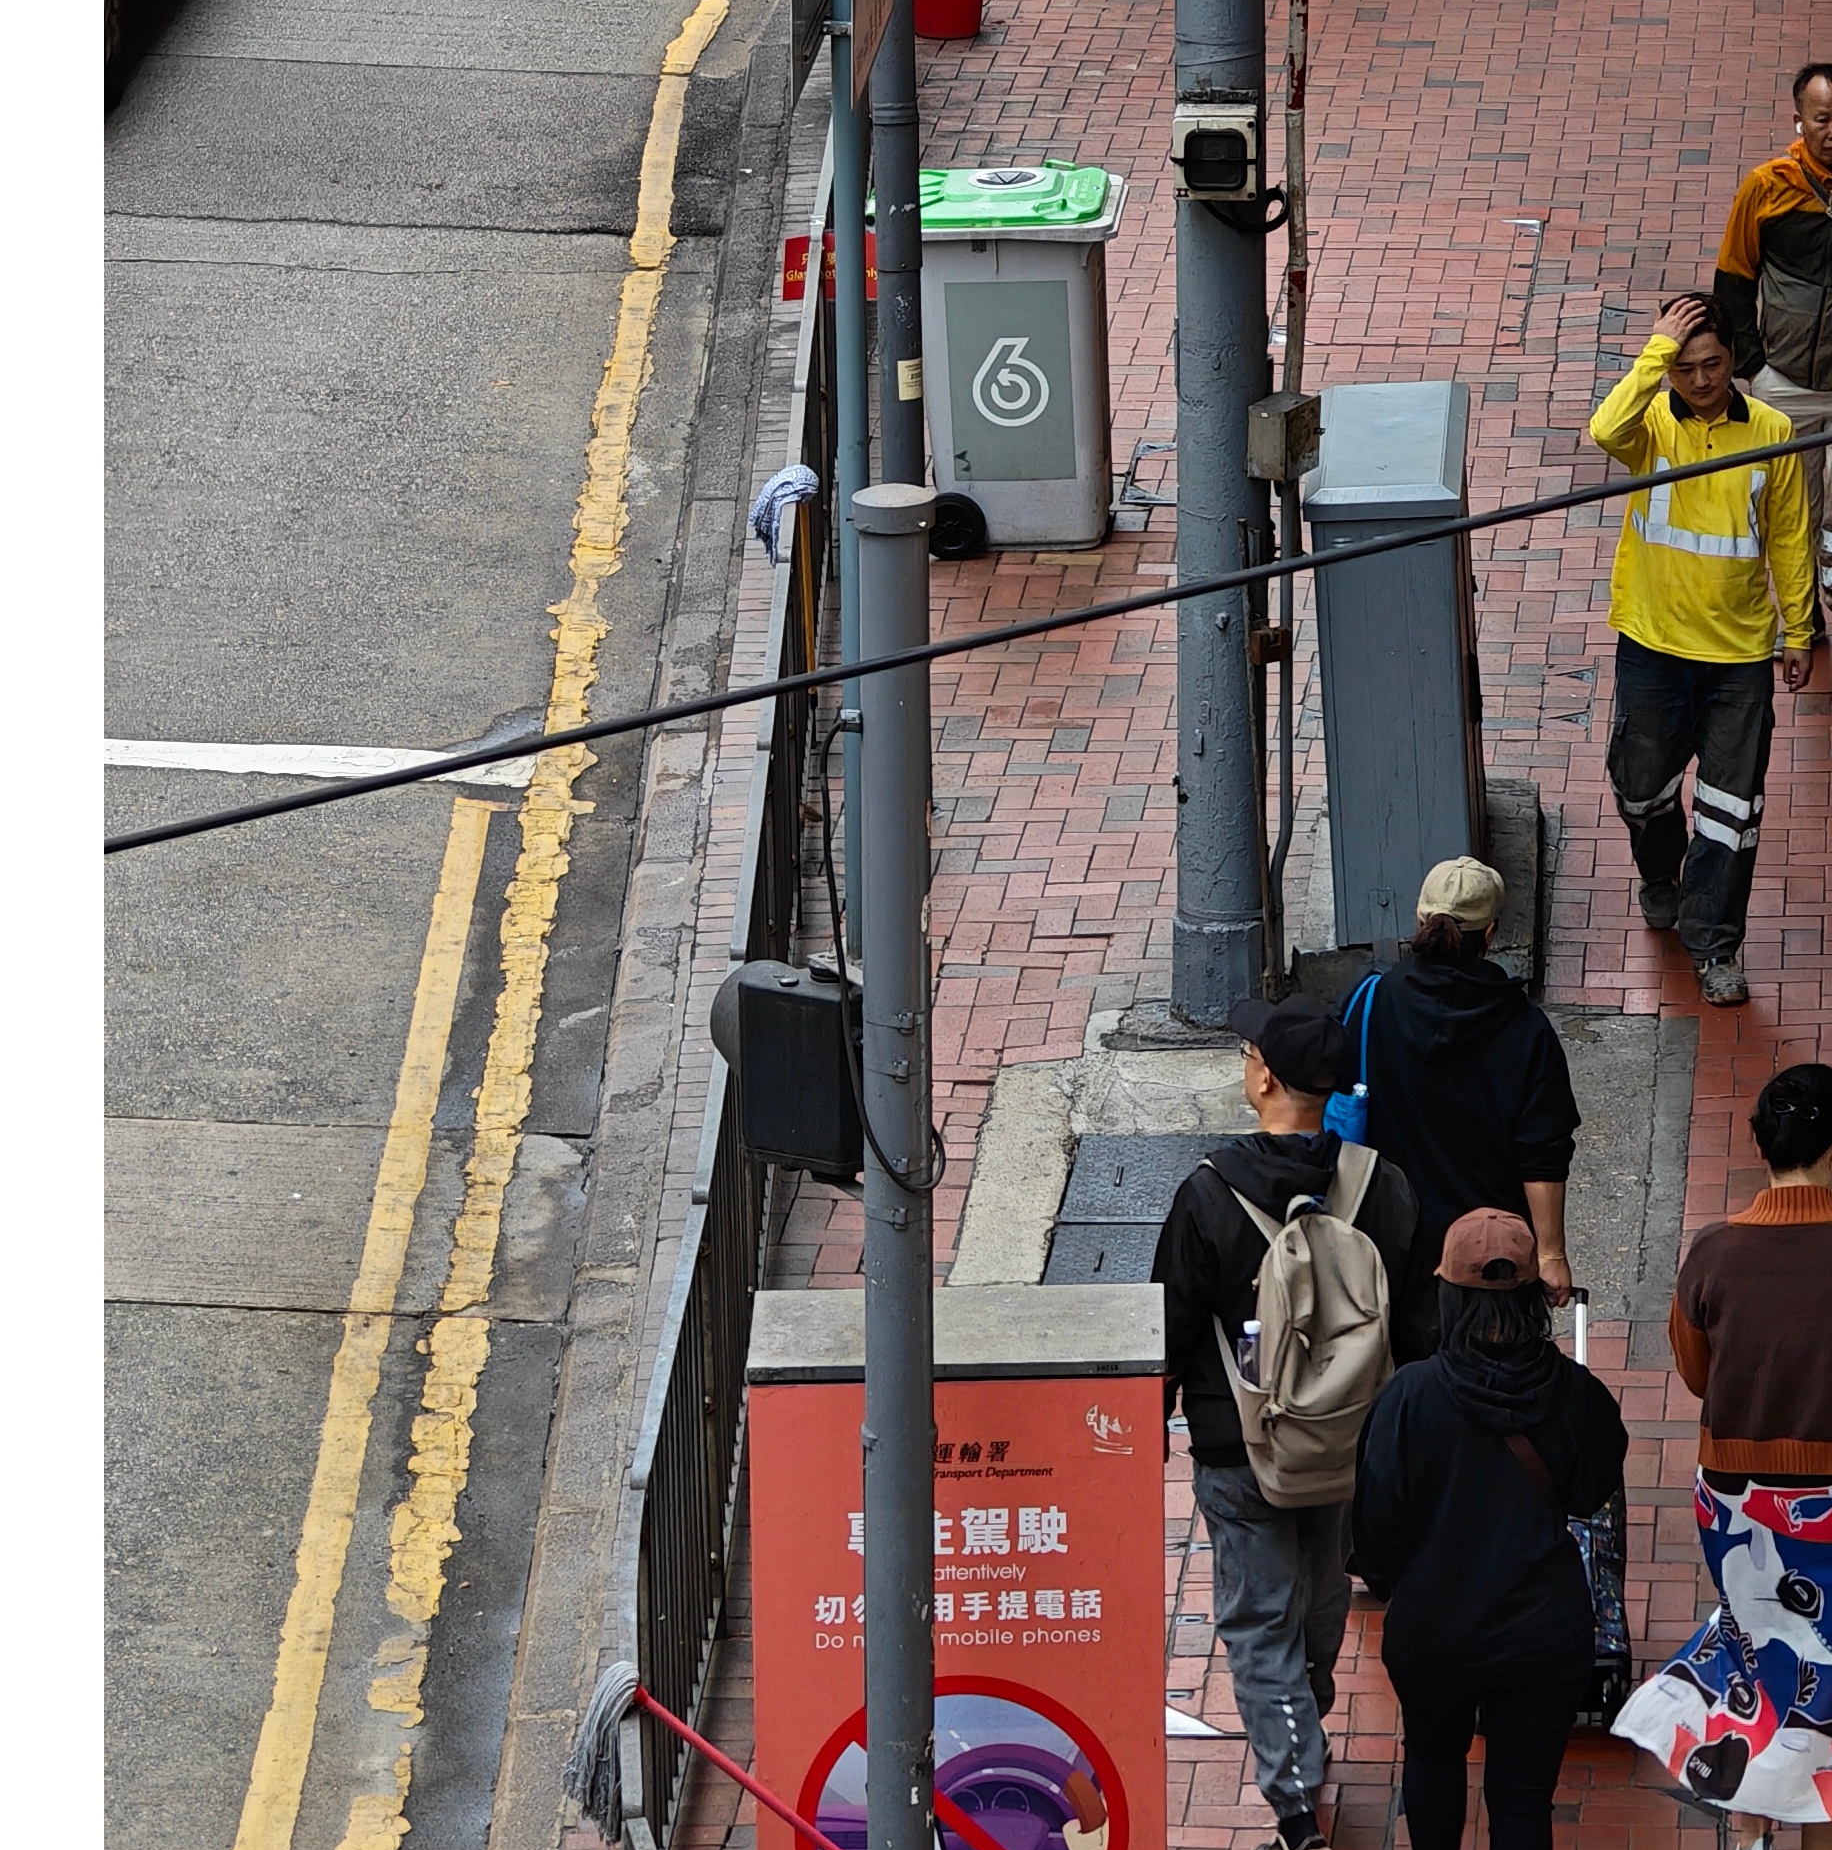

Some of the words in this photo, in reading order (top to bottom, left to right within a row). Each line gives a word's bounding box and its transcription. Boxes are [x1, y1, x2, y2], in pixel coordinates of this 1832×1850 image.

[933, 1441, 1010, 1464] 運輸署
[985, 1466, 1054, 1480] Department
[934, 1563, 1027, 1582] attentively
[814, 1589, 1103, 1625] 切用手提電話
[815, 1633, 845, 1649] Do
[940, 1629, 1014, 1647] mobile
[1022, 1628, 1101, 1647] phones
